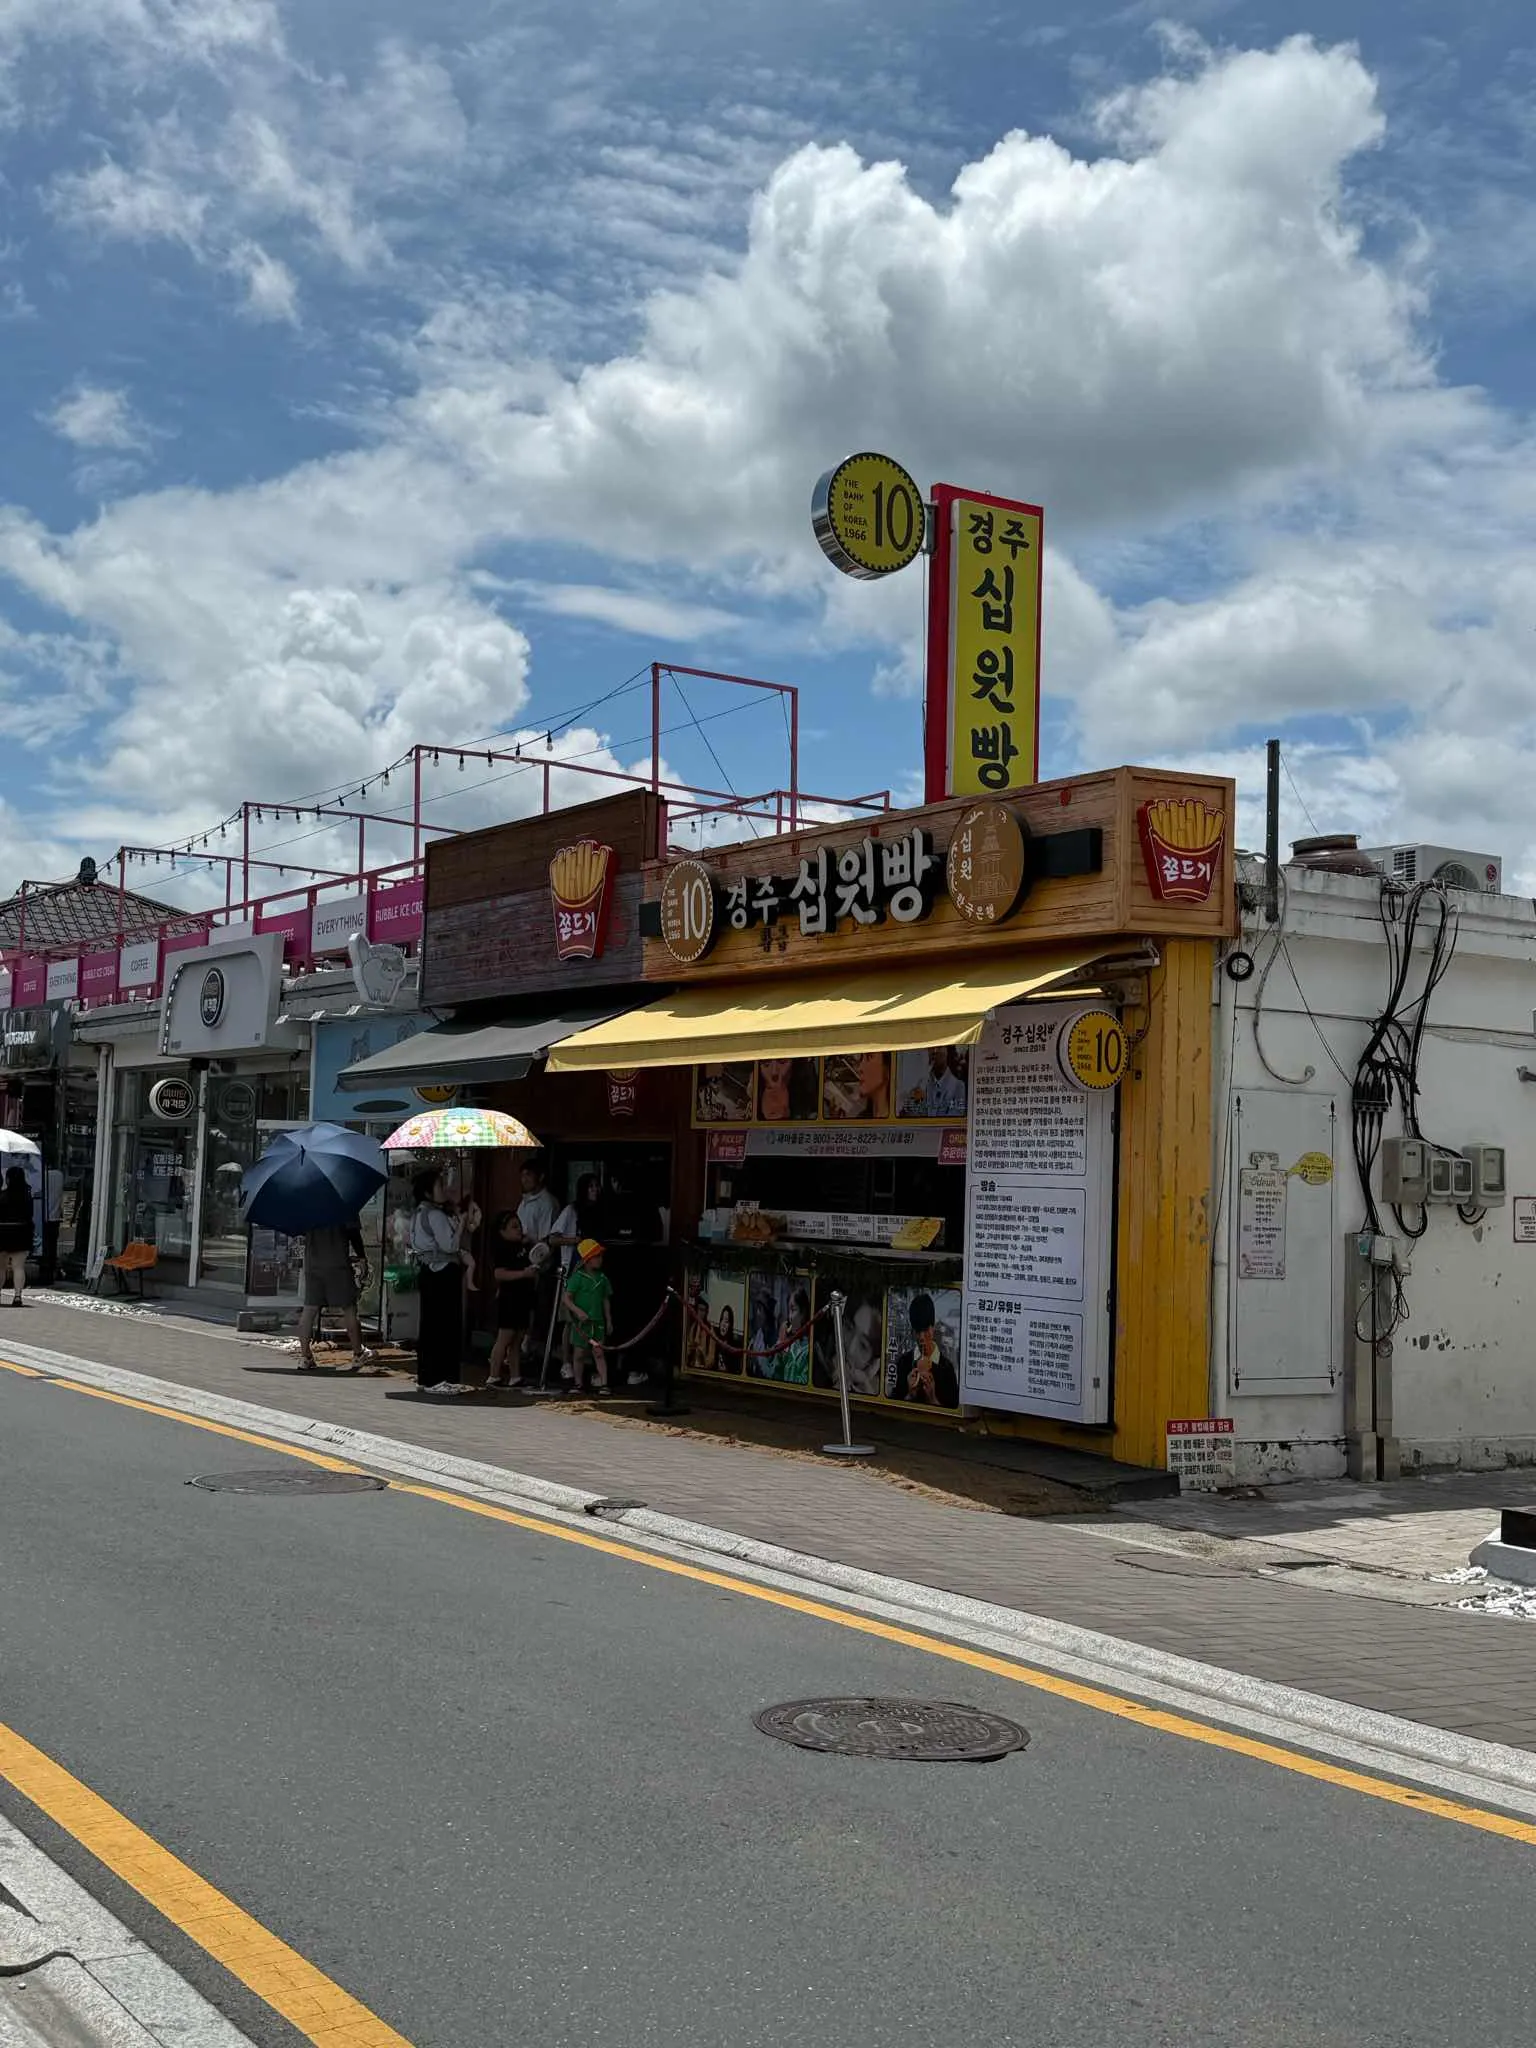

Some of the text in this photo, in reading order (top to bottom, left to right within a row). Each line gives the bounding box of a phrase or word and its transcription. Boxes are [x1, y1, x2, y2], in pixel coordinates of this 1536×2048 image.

[844, 479, 859, 488] THE
[844, 490, 864, 501] BANK
[844, 502, 853, 511] OF
[844, 513, 868, 527] KOREA
[873, 481, 913, 552] 10
[845, 527, 866, 541] 1966
[968, 510, 1030, 561] 경주
[961, 829, 972, 880] 십원
[726, 875, 779, 930] 경주
[789, 827, 941, 938] 십원빵
[376, 900, 424, 922] BUBBLE ICE CRE
[682, 879, 706, 940] 10
[317, 912, 364, 936] EVERYTHING
[130, 957, 149, 971] COFFEE
[1096, 1028, 1121, 1074] 10
[980, 1180, 997, 1192] 방송
[978, 1298, 1022, 1314] 광고/유튜브
